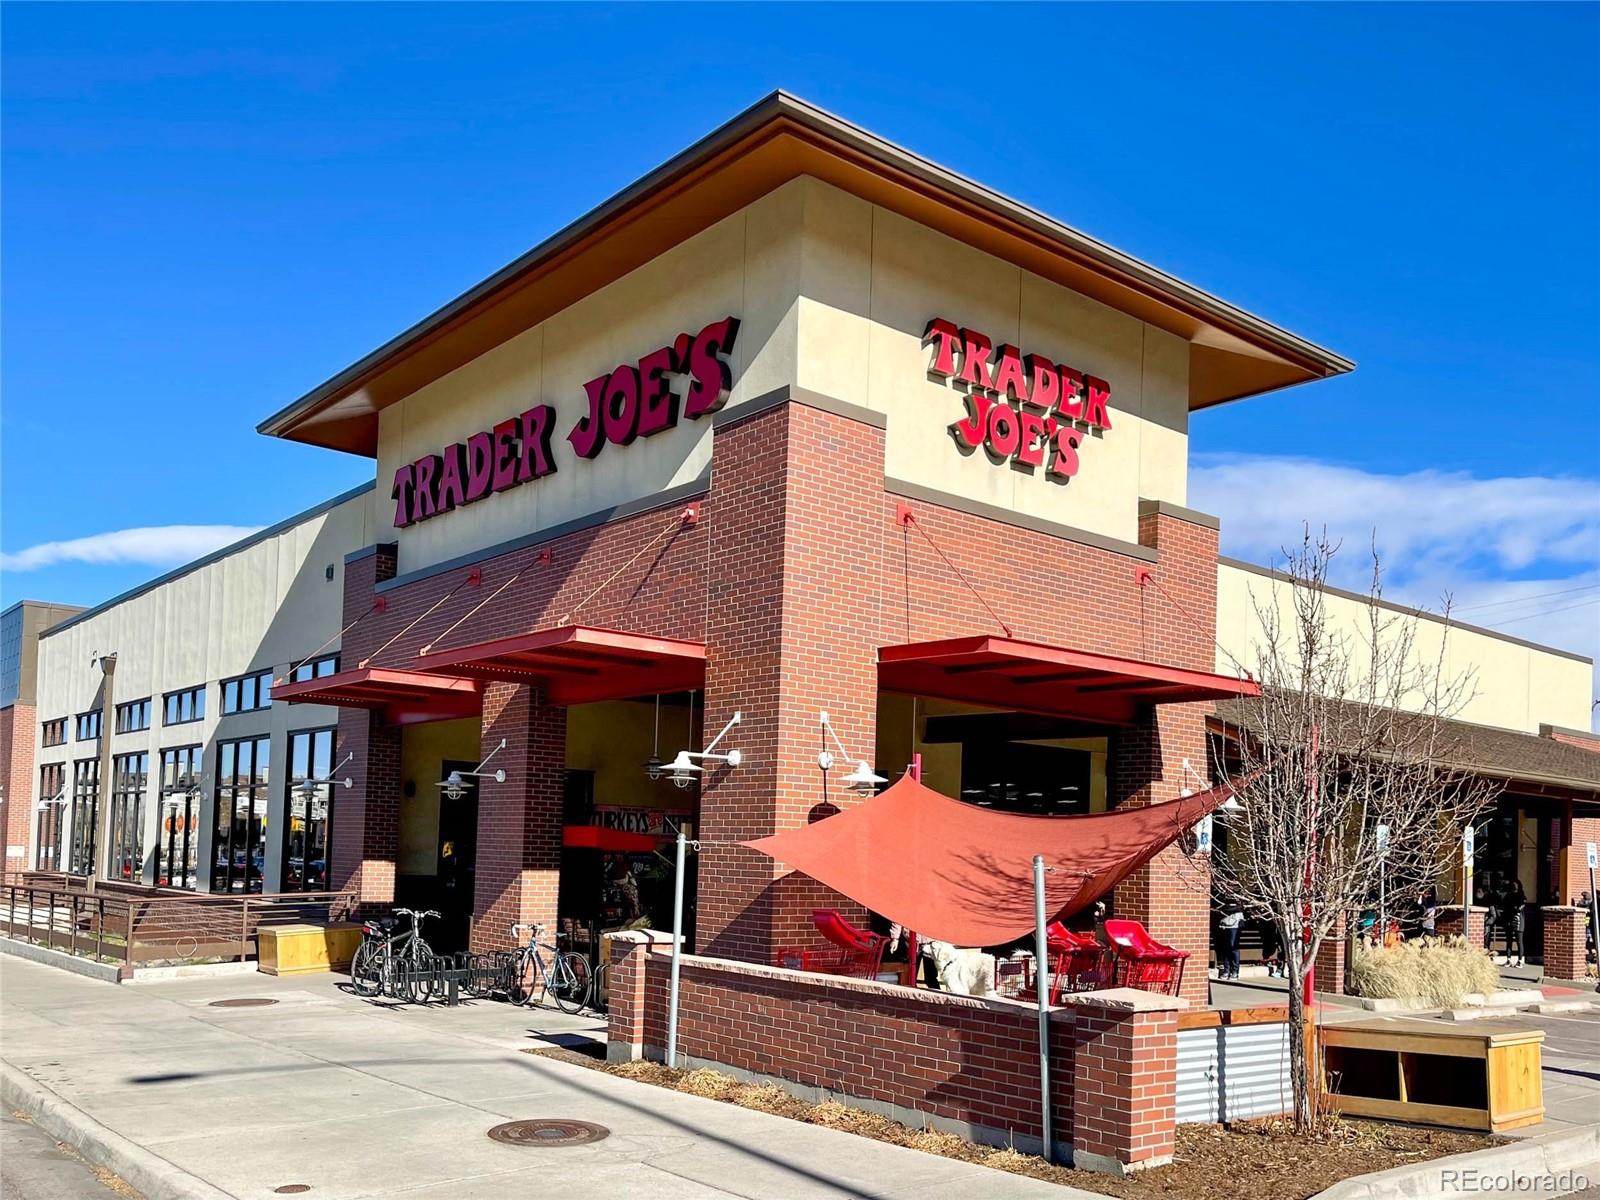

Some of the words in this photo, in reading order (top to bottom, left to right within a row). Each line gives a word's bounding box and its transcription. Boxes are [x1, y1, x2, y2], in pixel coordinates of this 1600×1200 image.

[392, 404, 557, 528] TRADER
[567, 316, 741, 459] JOE'S
[922, 317, 1112, 437] TRADER
[948, 393, 1085, 484] JOE'S
